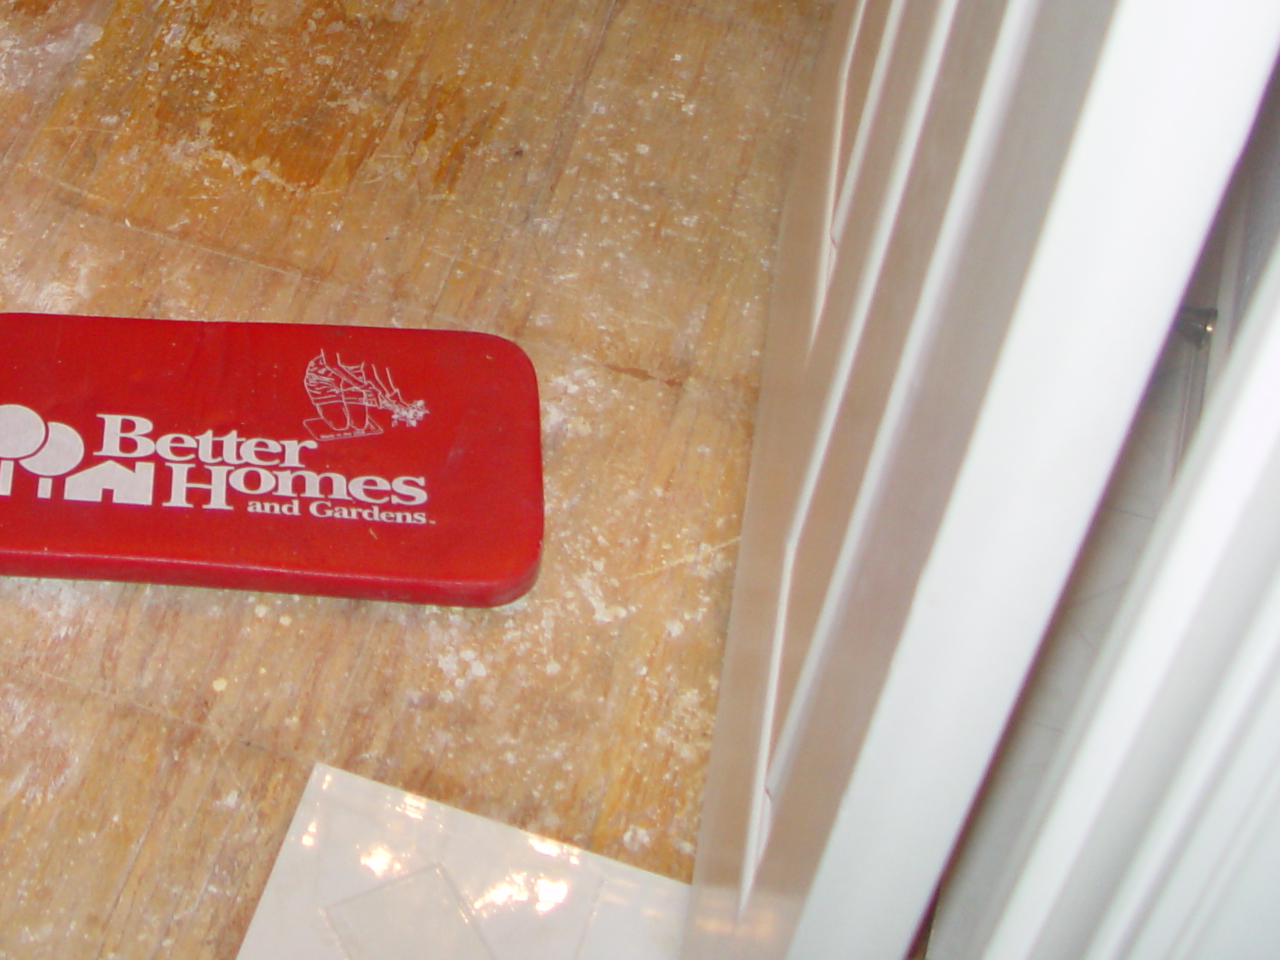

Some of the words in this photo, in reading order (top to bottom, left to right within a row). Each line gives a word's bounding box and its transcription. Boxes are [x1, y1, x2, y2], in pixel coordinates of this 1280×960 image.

[93, 413, 319, 468] Better
[162, 462, 428, 511] Homes
[247, 499, 301, 516] and
[309, 500, 427, 525] Gardens
